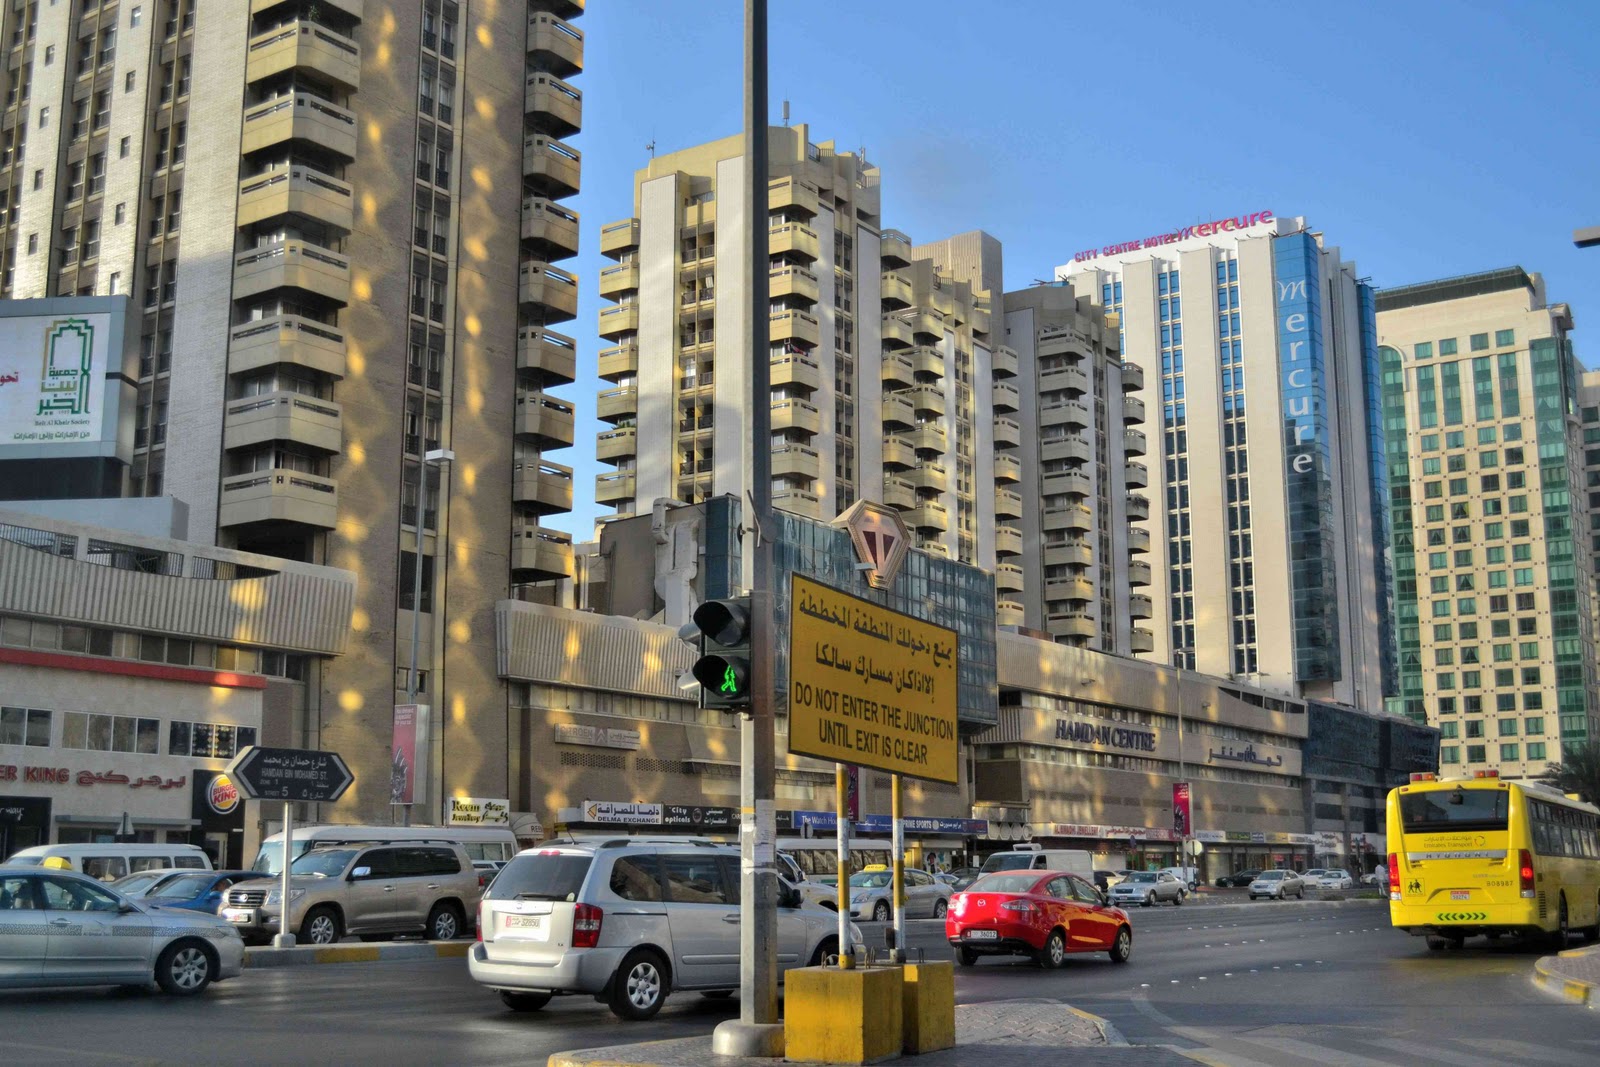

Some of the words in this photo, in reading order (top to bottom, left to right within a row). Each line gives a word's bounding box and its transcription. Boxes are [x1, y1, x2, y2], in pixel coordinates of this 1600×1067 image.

[1074, 249, 1098, 263] CITY
[1102, 239, 1142, 257] CENTRE
[1143, 233, 1175, 249] HOTEL
[71, 419, 91, 427] Society
[795, 681, 812, 707] DO
[815, 687, 839, 713] NOT
[842, 694, 879, 723] ENTER
[881, 704, 902, 729] THE
[904, 710, 954, 741] JUNCTION
[1055, 718, 1111, 746] HAMDAN
[1111, 727, 1156, 752] CENTRE
[819, 718, 853, 749] UNTIL
[856, 729, 880, 754] EXIT
[882, 735, 892, 758] IS
[894, 738, 928, 765] CLEAR
[263, 755, 281, 765] محمد
[282, 757, 289, 767] بن
[291, 755, 310, 767] حمدان
[311, 756, 327, 770] شارع
[24, 766, 70, 784] KING
[261, 768, 284, 778] HAMDAN
[285, 768, 294, 778] BIN
[294, 769, 318, 780] MOHAMED
[213, 790, 237, 804] KING
[281, 786, 289, 797] 5
[452, 800, 480, 812] Reem
[802, 815, 811, 823] The
[812, 815, 827, 824] Watch
[916, 820, 932, 829] SPORTS
